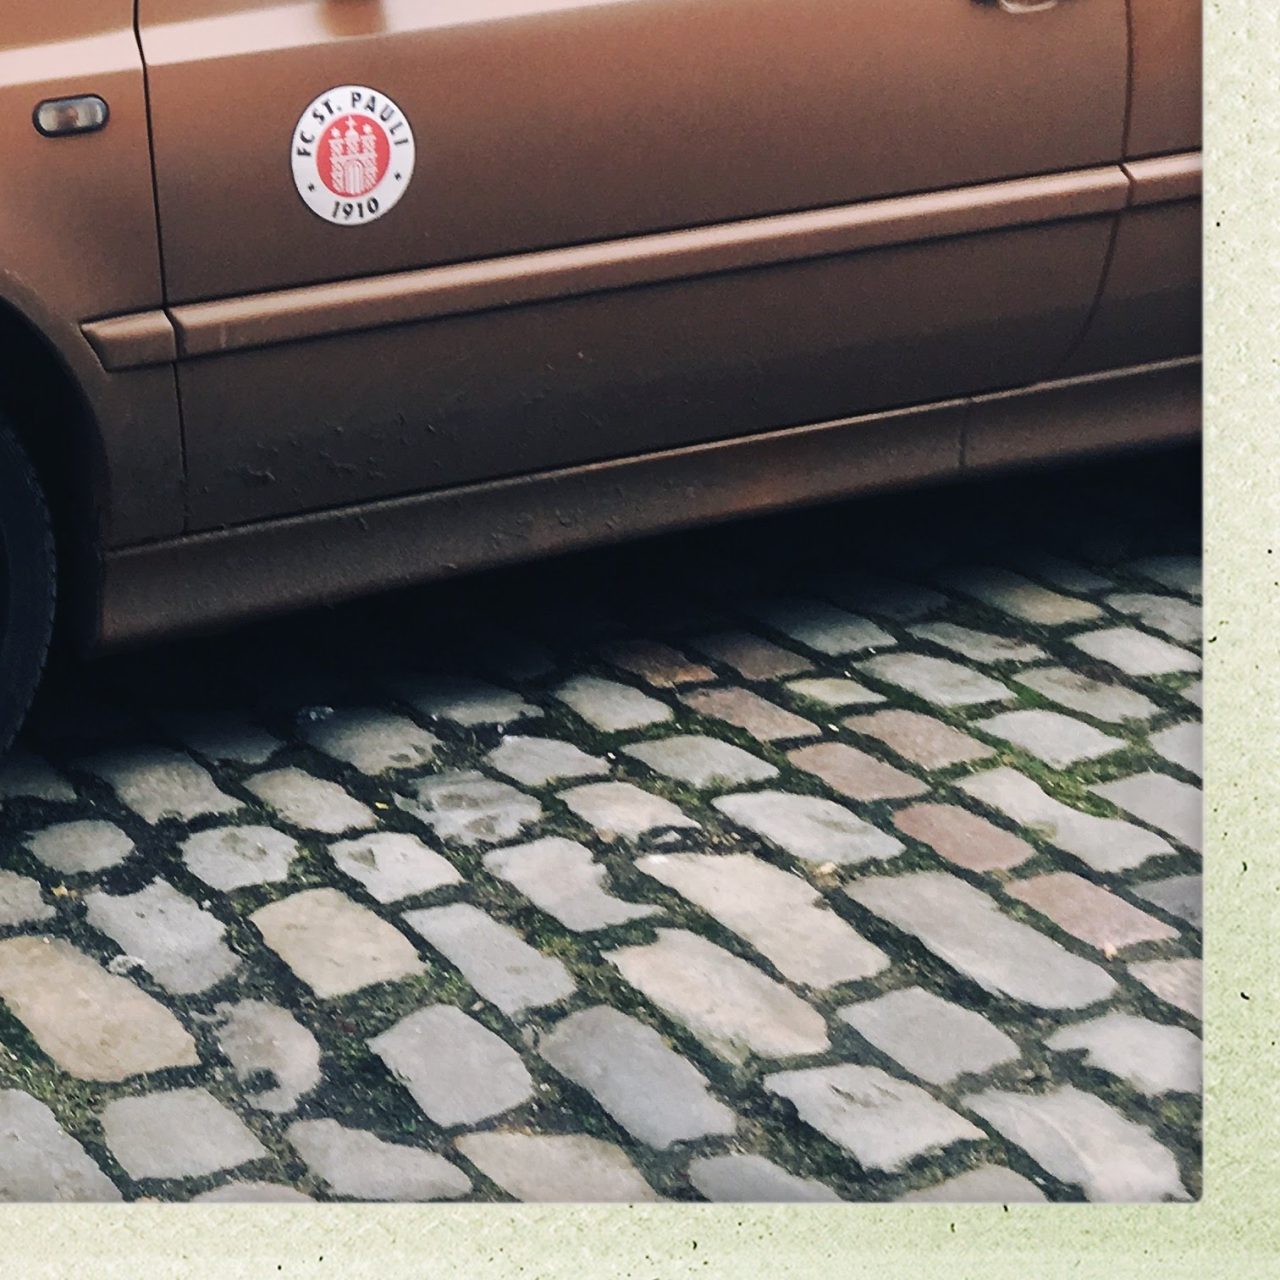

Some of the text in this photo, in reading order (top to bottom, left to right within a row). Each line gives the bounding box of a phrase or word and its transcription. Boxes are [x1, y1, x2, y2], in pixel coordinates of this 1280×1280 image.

[296, 90, 410, 157] FC ST. PAULI
[332, 197, 380, 219] 1910
